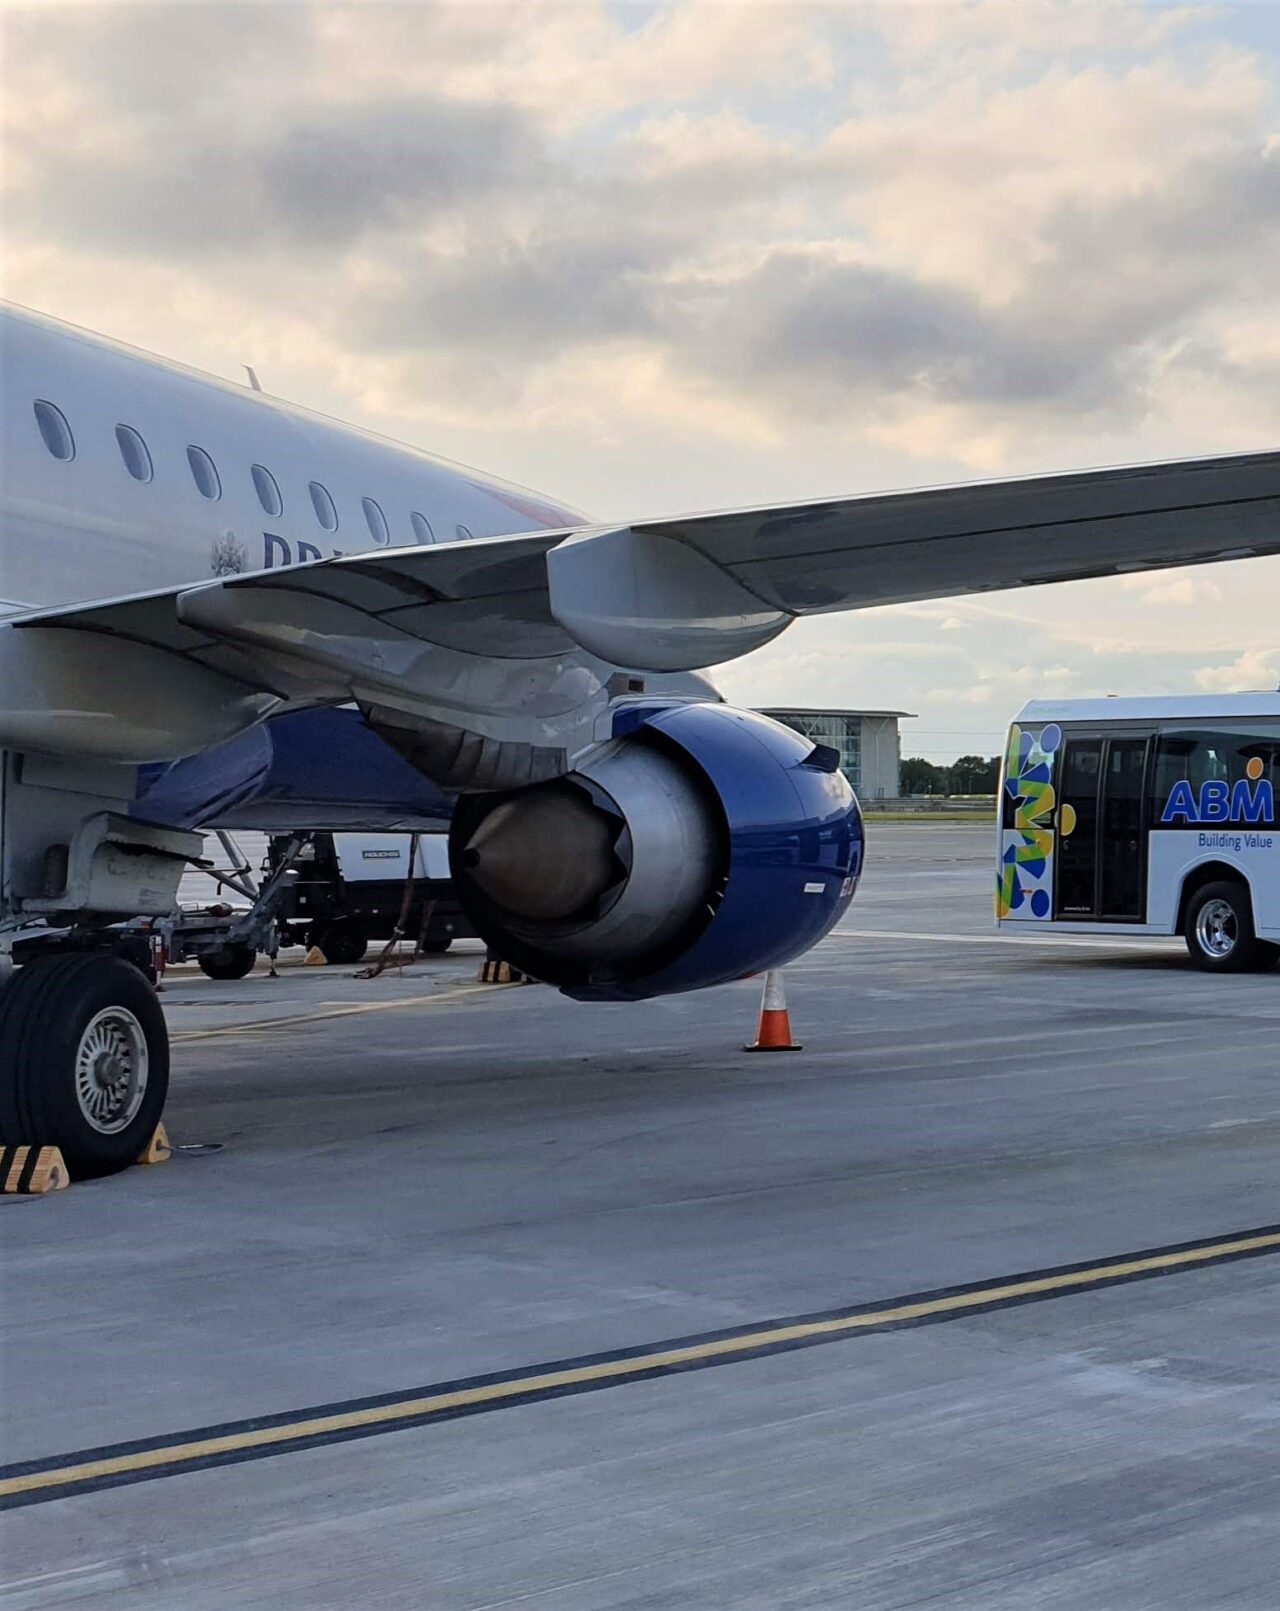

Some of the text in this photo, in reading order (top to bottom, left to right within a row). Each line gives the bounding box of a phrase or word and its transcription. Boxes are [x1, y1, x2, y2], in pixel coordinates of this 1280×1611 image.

[1161, 779, 1275, 822] ABM
[1198, 833, 1274, 852] Building Value
